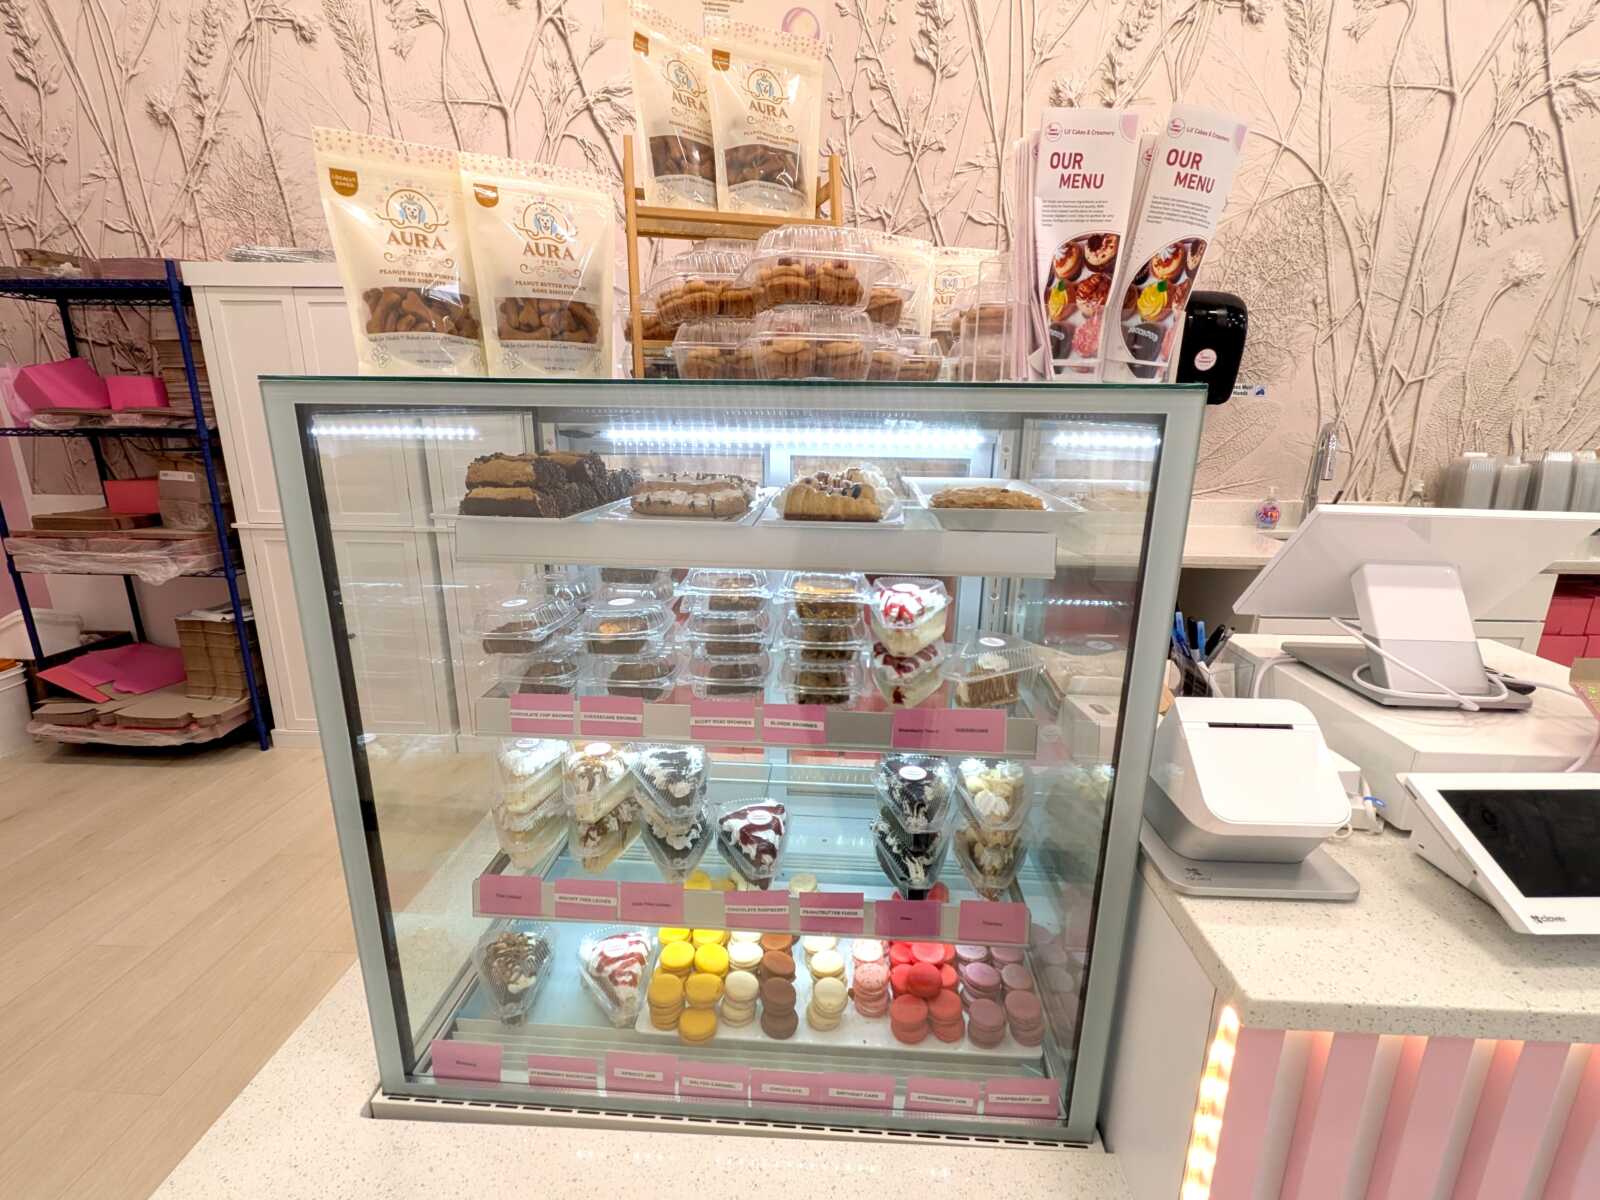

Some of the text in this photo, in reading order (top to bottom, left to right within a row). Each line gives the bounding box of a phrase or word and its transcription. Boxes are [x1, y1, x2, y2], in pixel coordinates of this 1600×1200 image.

[749, 100, 789, 119] AURA
[1050, 152, 1084, 170] OUR
[1166, 148, 1203, 171] OUR
[1059, 173, 1104, 189] MENU
[1174, 171, 1215, 194] MENU
[387, 230, 446, 250] AURA
[523, 241, 575, 261] AURA
[407, 270, 433, 278] BUTTER
[540, 281, 563, 289] BUTTER
